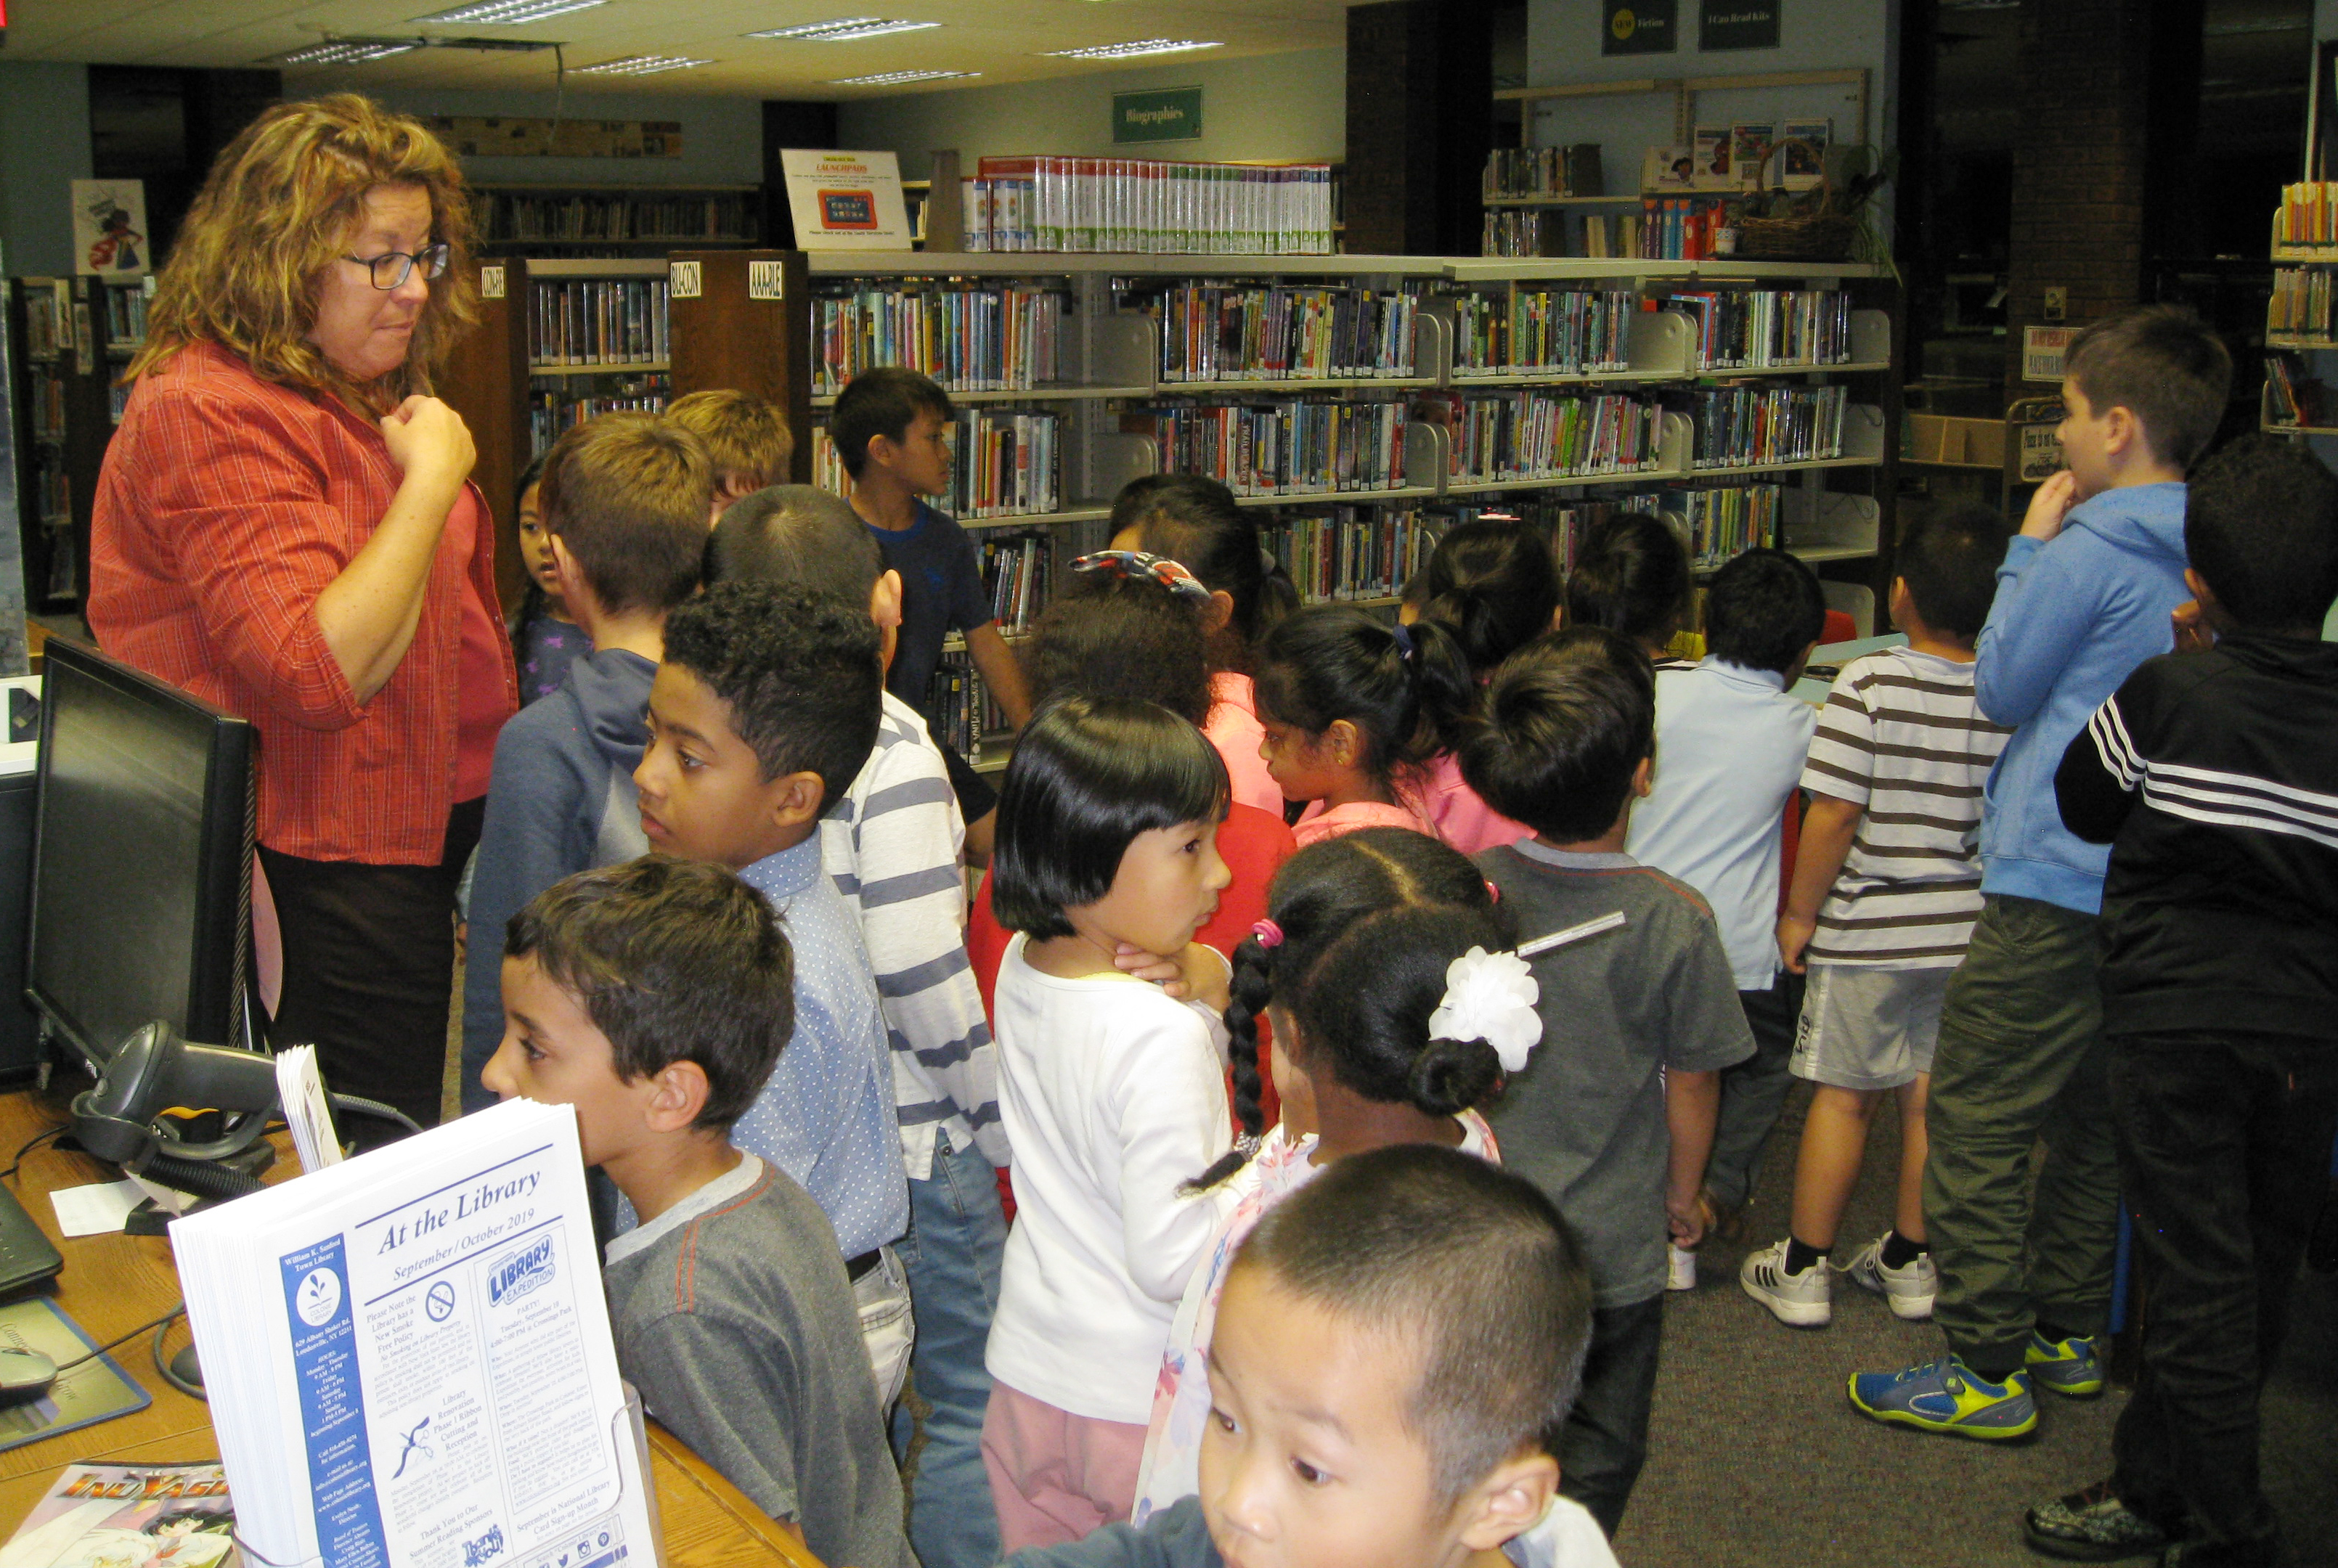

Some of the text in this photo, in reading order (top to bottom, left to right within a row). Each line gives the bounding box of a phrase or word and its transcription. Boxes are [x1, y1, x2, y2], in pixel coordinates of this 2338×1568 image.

[1637, 18, 1665, 28] Fiction
[1713, 15, 1729, 24] Can
[1730, 12, 1752, 23] Read
[1753, 11, 1770, 21] Kits
[1126, 105, 1185, 124] Biographies
[816, 163, 867, 173] LAUNCHPADS
[752, 264, 781, 297] AAA-BLE
[378, 1172, 539, 1255] At the Library
[508, 1208, 534, 1229] 2019
[285, 1253, 309, 1265] William
[319, 1238, 340, 1252] Sanford
[295, 1252, 333, 1271] Town Library
[491, 1241, 550, 1301] LIBRARY
[504, 1269, 554, 1301] EXPEDITION
[311, 1310, 333, 1323] LIBRARY
[367, 1296, 415, 1323] Please Note the
[525, 1306, 551, 1321] September
[372, 1317, 395, 1332] Library
[397, 1311, 408, 1320] has
[375, 1320, 412, 1342] New Smoke
[1, 1323, 30, 1349] Connec
[378, 1333, 412, 1353] Free Policy
[56, 1378, 78, 1400] Grow
[443, 1390, 465, 1405] Library
[433, 1421, 452, 1434] Phase
[459, 1405, 481, 1421] Ribbon
[438, 1398, 474, 1419] Renovation
[441, 1417, 478, 1441] Cutting and
[445, 1432, 477, 1451] Reception
[517, 1511, 549, 1532] September
[558, 1491, 585, 1510] National
[587, 1482, 609, 1495] Library
[534, 1498, 598, 1534] Card Sign-up Month
[421, 1524, 441, 1539] Thank
[442, 1517, 456, 1527] You
[465, 1505, 477, 1515] Our
[410, 1541, 435, 1559] Summer
[437, 1526, 463, 1543] Reading
[464, 1509, 492, 1528] Sponsors
